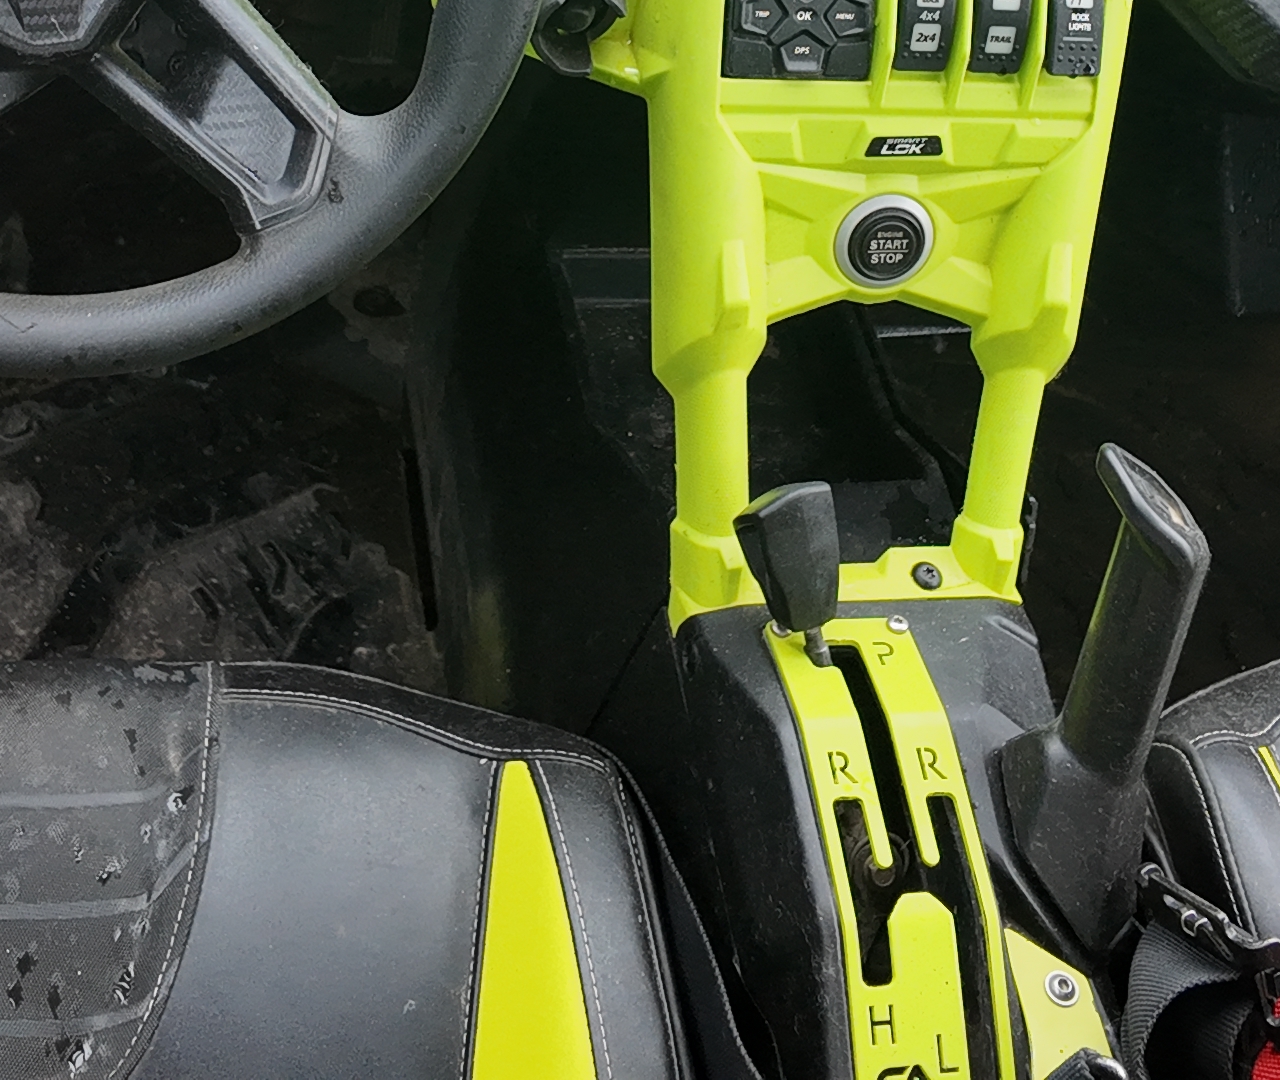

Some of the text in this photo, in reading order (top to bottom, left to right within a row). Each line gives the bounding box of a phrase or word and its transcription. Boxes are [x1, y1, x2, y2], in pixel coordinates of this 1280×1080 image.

[797, 11, 813, 21] OK
[835, 13, 855, 21] MENU
[919, 11, 941, 21] 4x4
[1071, 13, 1090, 22] ROCK
[1069, 23, 1092, 32] LIGHTS
[916, 33, 937, 43] 2x4
[990, 36, 1012, 44] TRAIL
[795, 47, 810, 55] DPS
[870, 240, 909, 250] START
[871, 253, 904, 264] STOP
[872, 642, 894, 665] P
[827, 751, 859, 785] R
[916, 747, 948, 780] R
[869, 1004, 898, 1046] H
[937, 1034, 960, 1074] L
